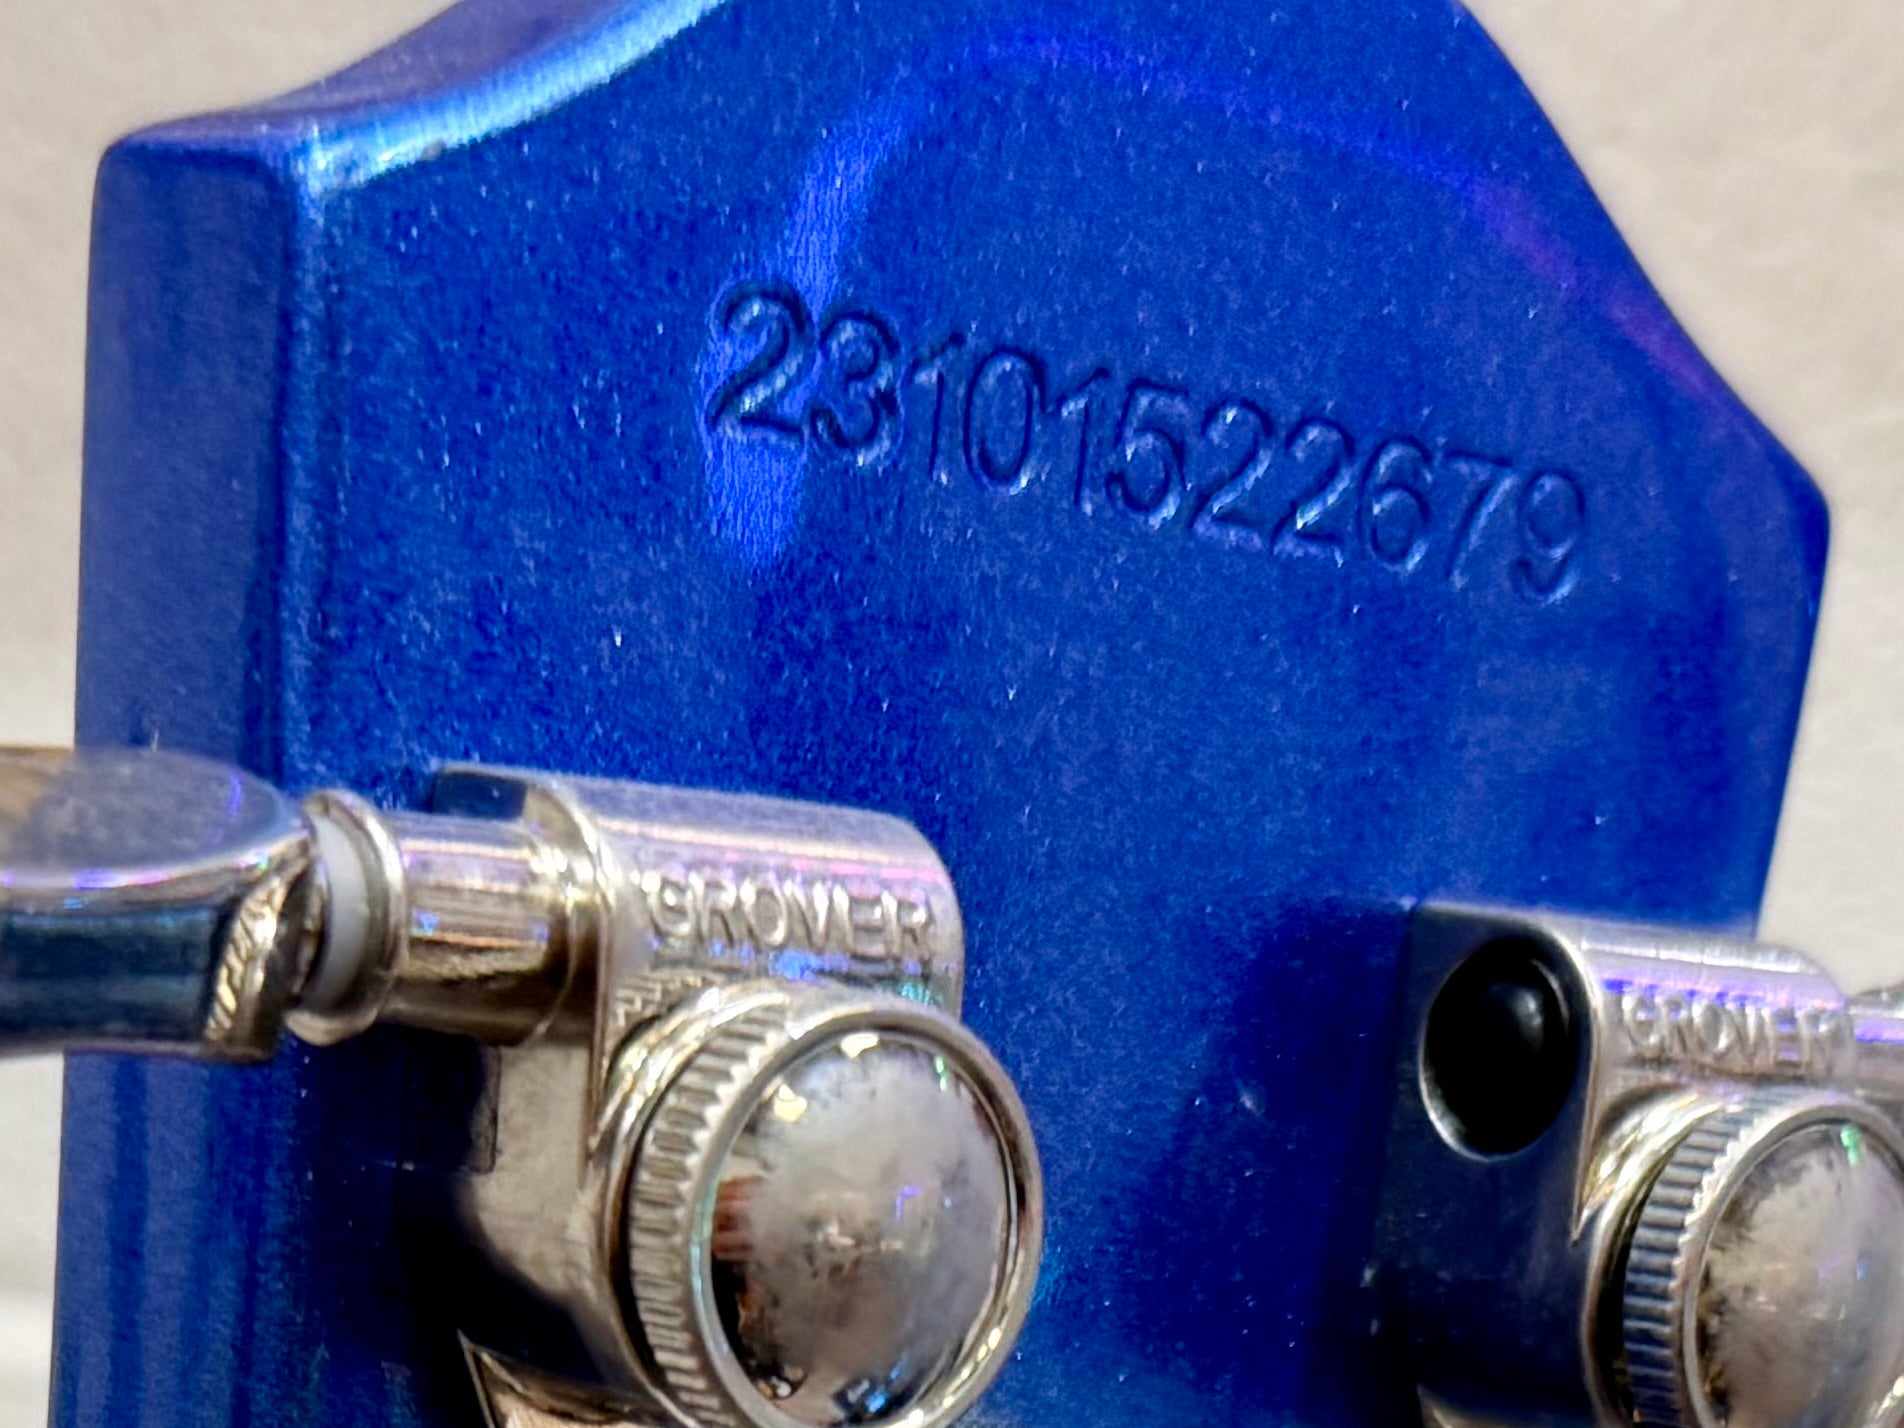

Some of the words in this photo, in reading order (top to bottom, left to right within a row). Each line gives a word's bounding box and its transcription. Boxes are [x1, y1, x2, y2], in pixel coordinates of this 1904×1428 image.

[708, 280, 1586, 600] 23101522679
[648, 870, 930, 960] GROVER
[1622, 990, 1846, 1075] GROVER
